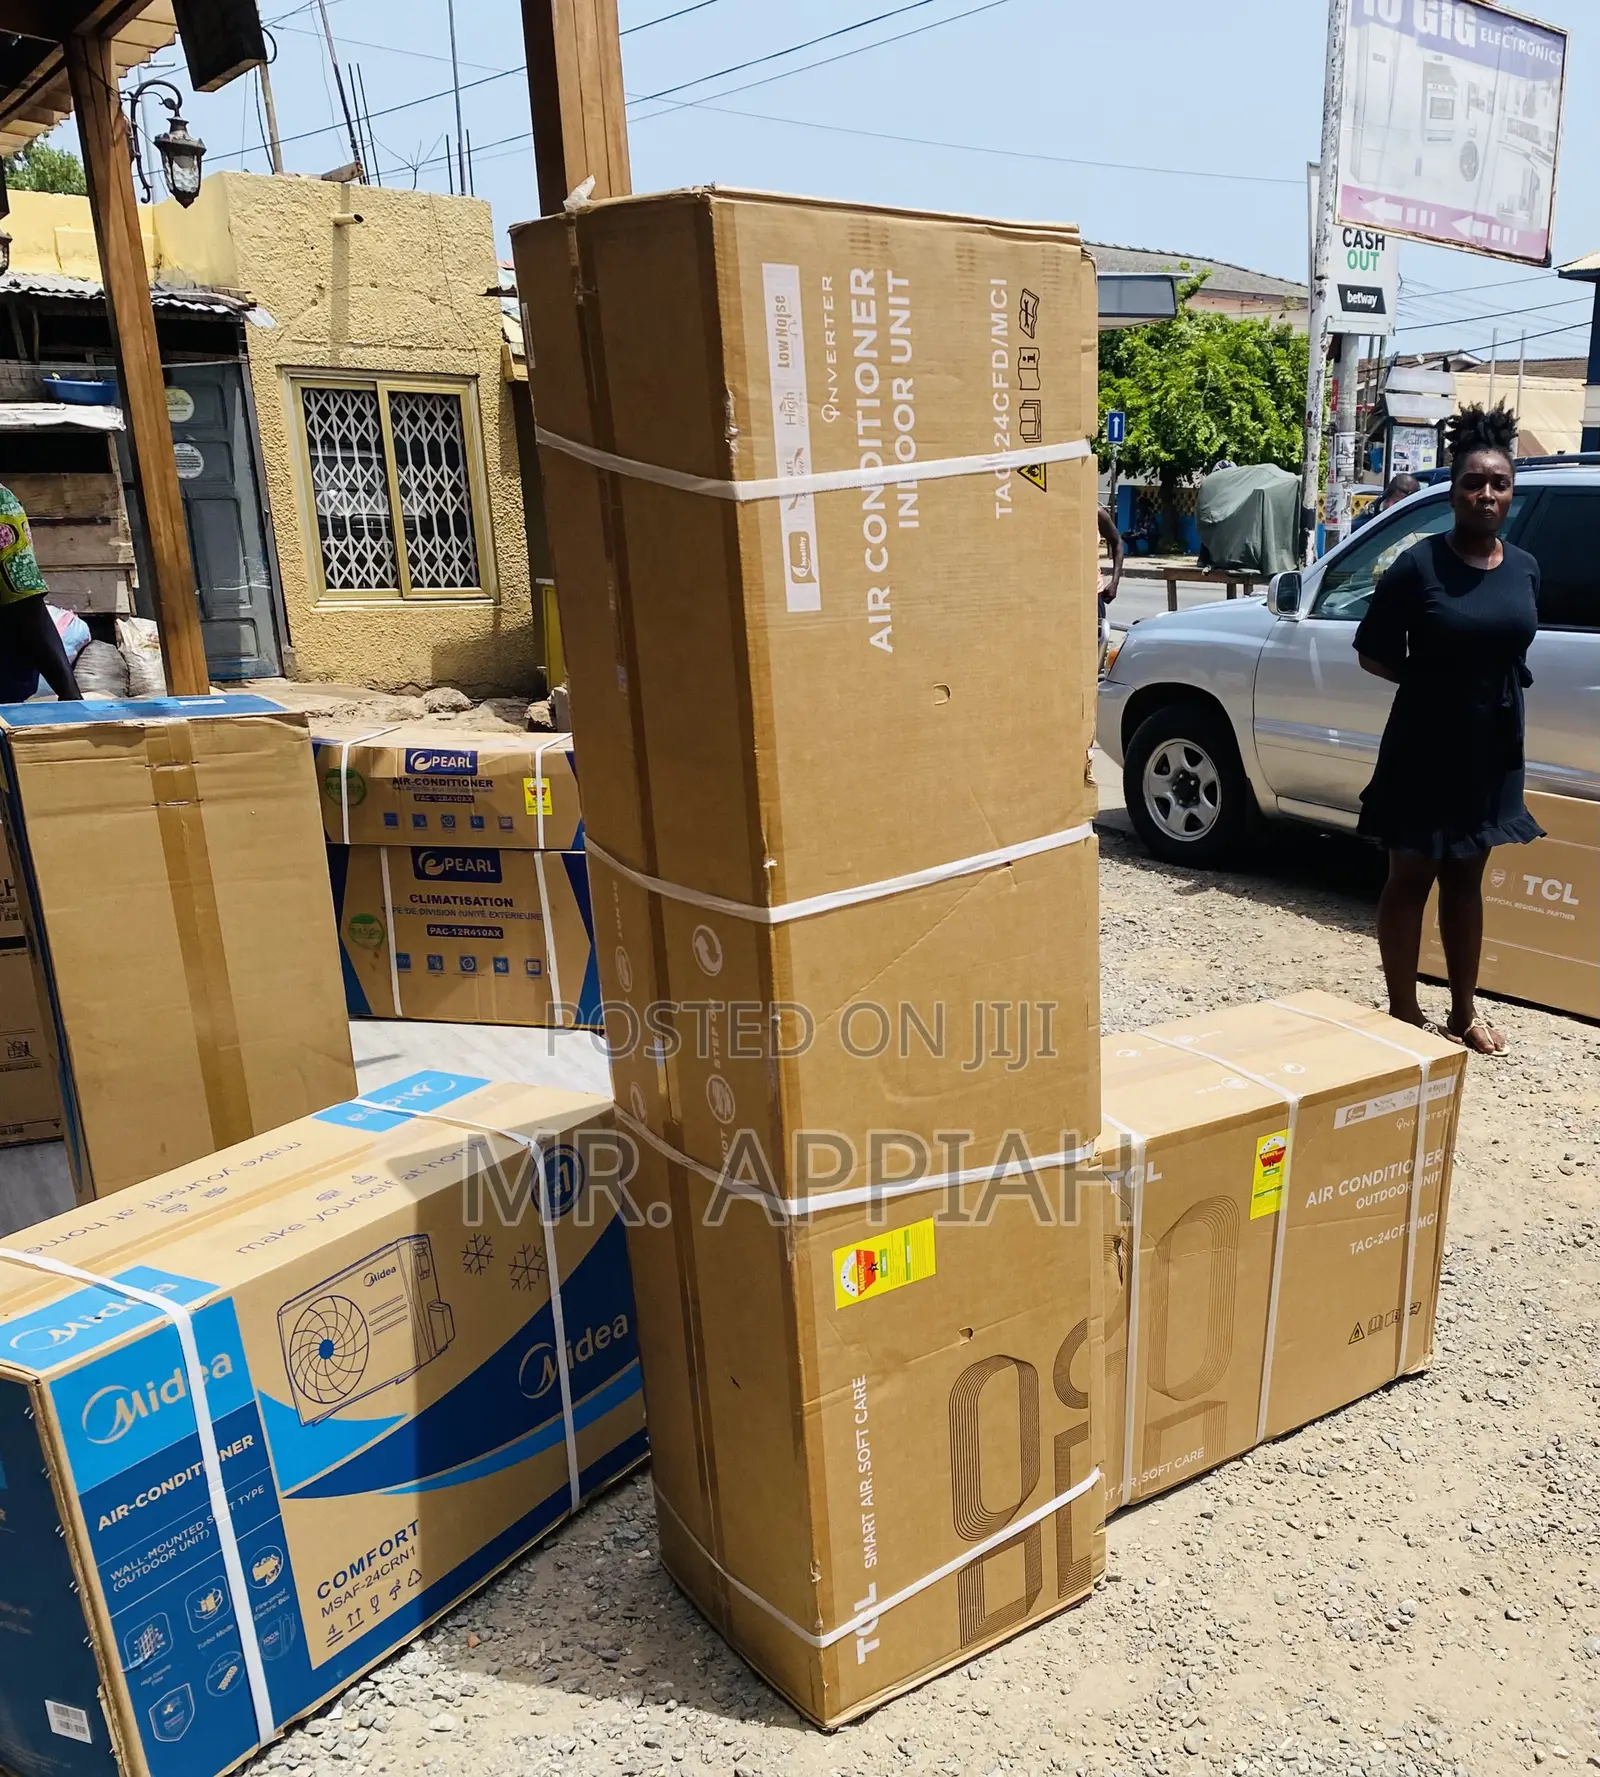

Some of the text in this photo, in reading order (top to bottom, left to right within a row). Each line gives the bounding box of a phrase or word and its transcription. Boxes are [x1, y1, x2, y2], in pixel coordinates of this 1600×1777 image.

[1479, 27, 1564, 67] ELECTRONICS
[1342, 227, 1386, 251] CASH
[1346, 248, 1380, 272] OUT
[1346, 289, 1378, 309] betway
[886, 268, 920, 529] INOOR UNIT
[867, 583, 894, 653] AIR
[392, 776, 494, 788] AIR-CONDITIONER
[409, 893, 514, 908] CLIMATISATION
[1485, 895, 1576, 921] OFFICIAL REGIONAL PARTNER
[1522, 874, 1579, 906] TCL
[418, 908, 457, 917] DIVISION
[236, 1138, 488, 1256] make yourself at home
[1304, 1148, 1443, 1209] AIR CONDITIOER
[1355, 1179, 1413, 1210] OUTDOOR
[363, 1266, 397, 1288] Midea
[851, 1374, 870, 1425] CARE
[1174, 1446, 1205, 1469] CARE
[97, 1433, 256, 1532] AIR-CONDITNER
[109, 1484, 265, 1581] WALL-MOUNTED TYPE
[862, 1511, 878, 1569] SMART
[112, 1528, 210, 1593] (OUTDOOR UNIT)
[316, 1518, 419, 1600] COMFORT
[320, 1544, 416, 1618] MSAF-24CRN1
